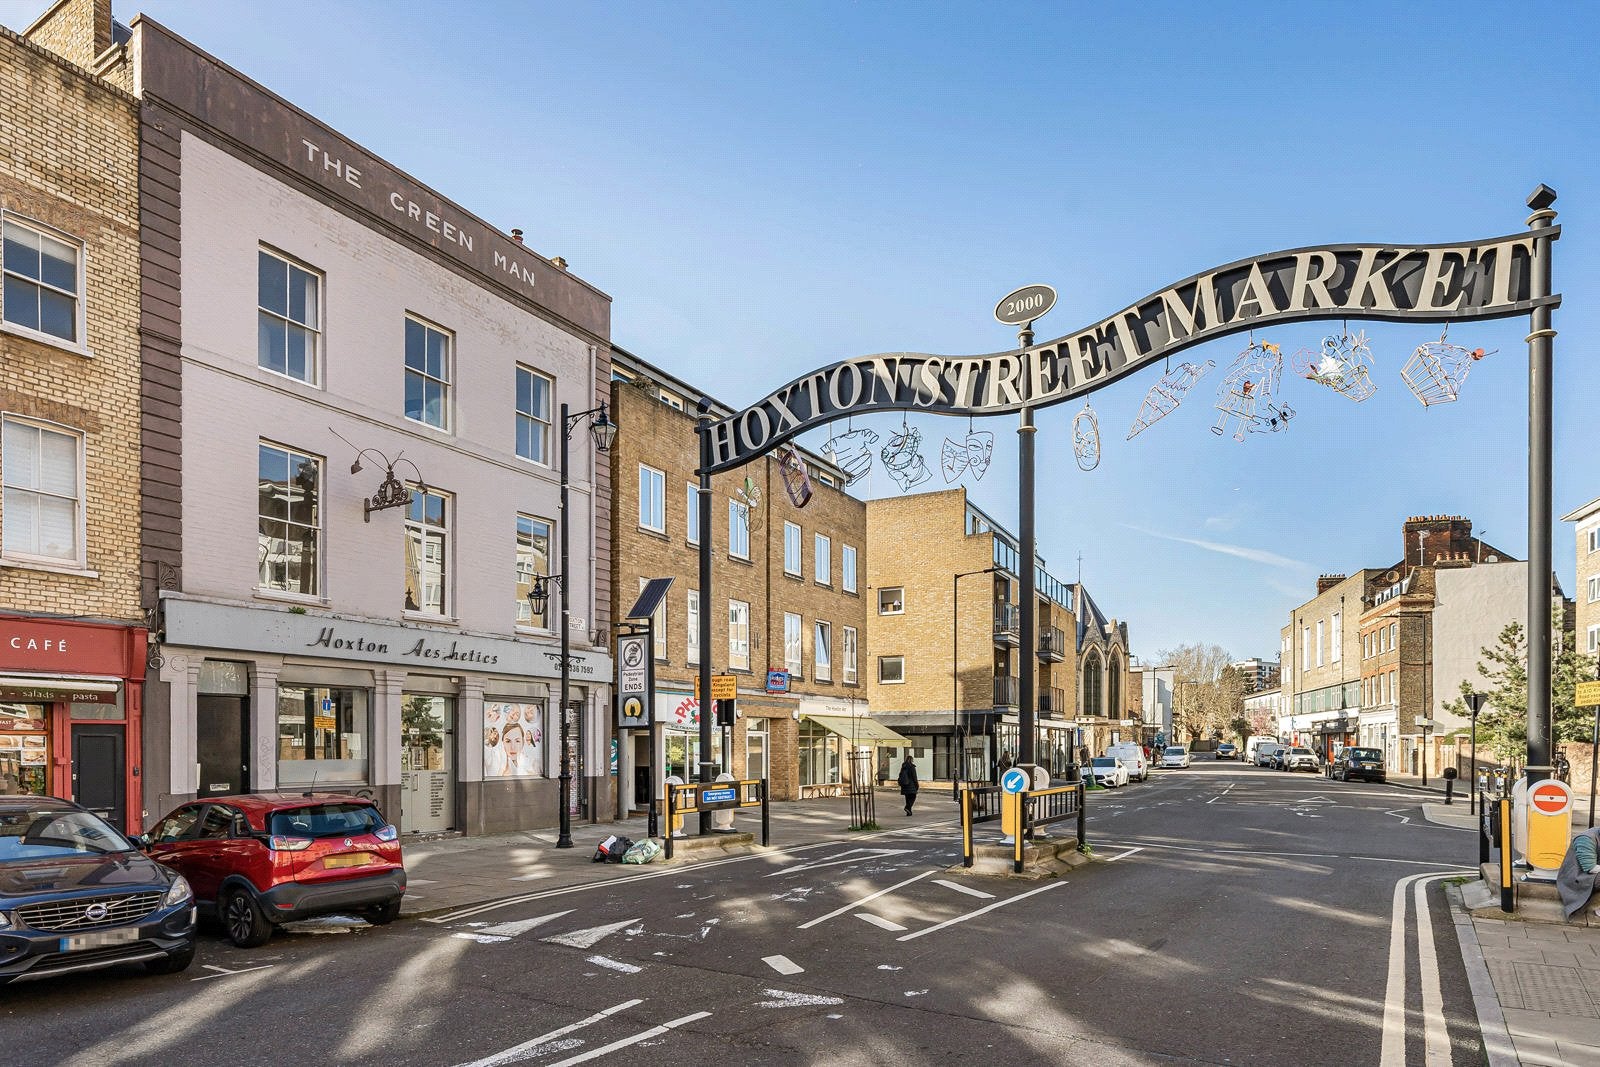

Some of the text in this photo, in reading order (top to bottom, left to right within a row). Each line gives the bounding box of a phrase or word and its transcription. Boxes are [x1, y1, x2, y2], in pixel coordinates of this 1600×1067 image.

[302, 138, 362, 190] THE
[494, 250, 535, 287] MAN
[1007, 293, 1043, 316] 2000
[707, 237, 1536, 468] HOXTON STREET MARKET
[10, 637, 67, 652] CAFÉ
[306, 626, 388, 654] Hoxton
[22, 690, 98, 701] salads pasta
[624, 682, 643, 691] ENDS
